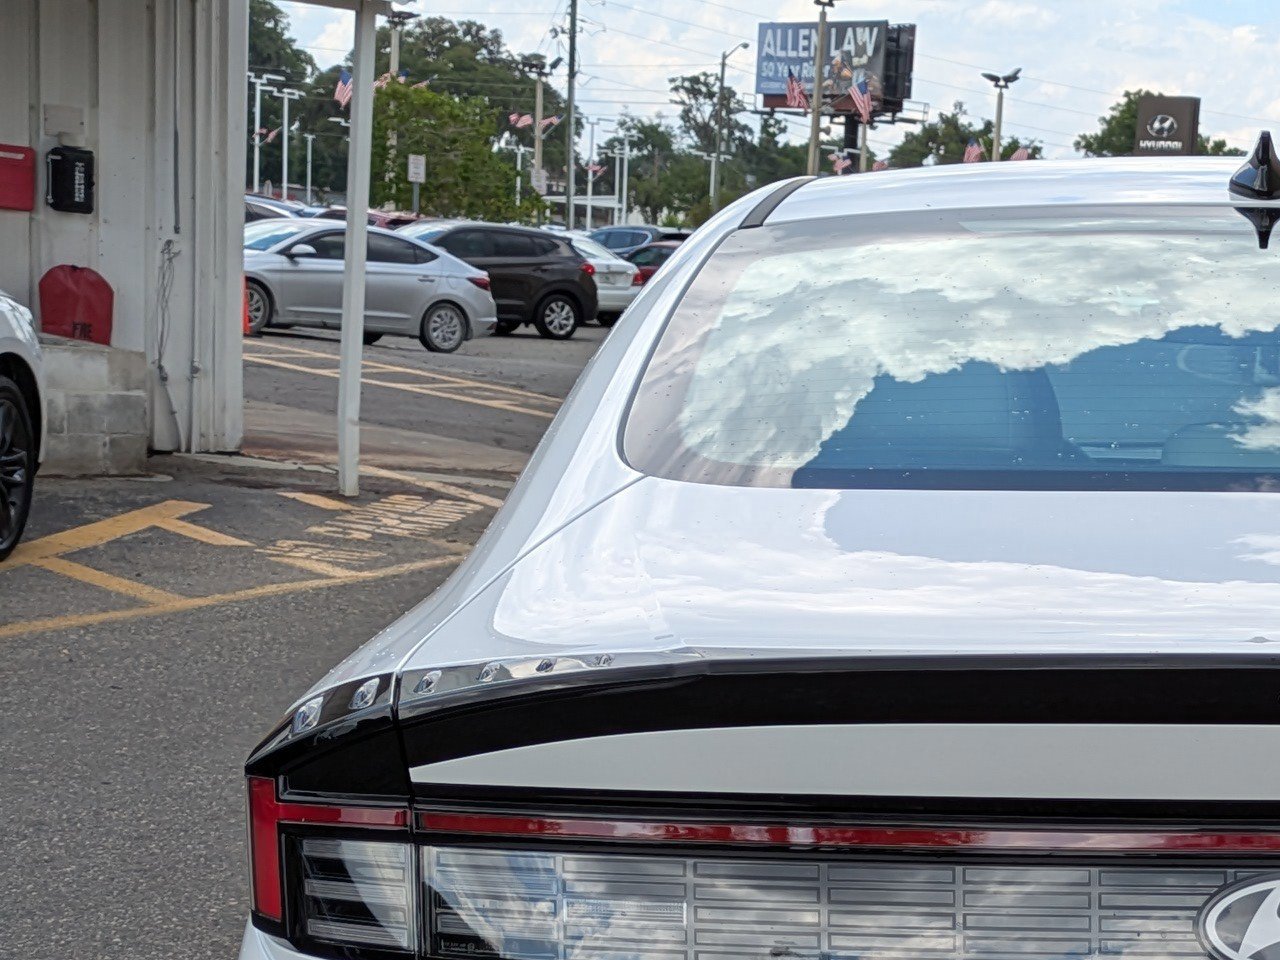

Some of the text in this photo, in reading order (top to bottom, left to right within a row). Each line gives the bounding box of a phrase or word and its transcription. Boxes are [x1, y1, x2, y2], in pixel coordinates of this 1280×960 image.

[761, 26, 878, 57] ALLEN LAW
[761, 61, 774, 78] 50
